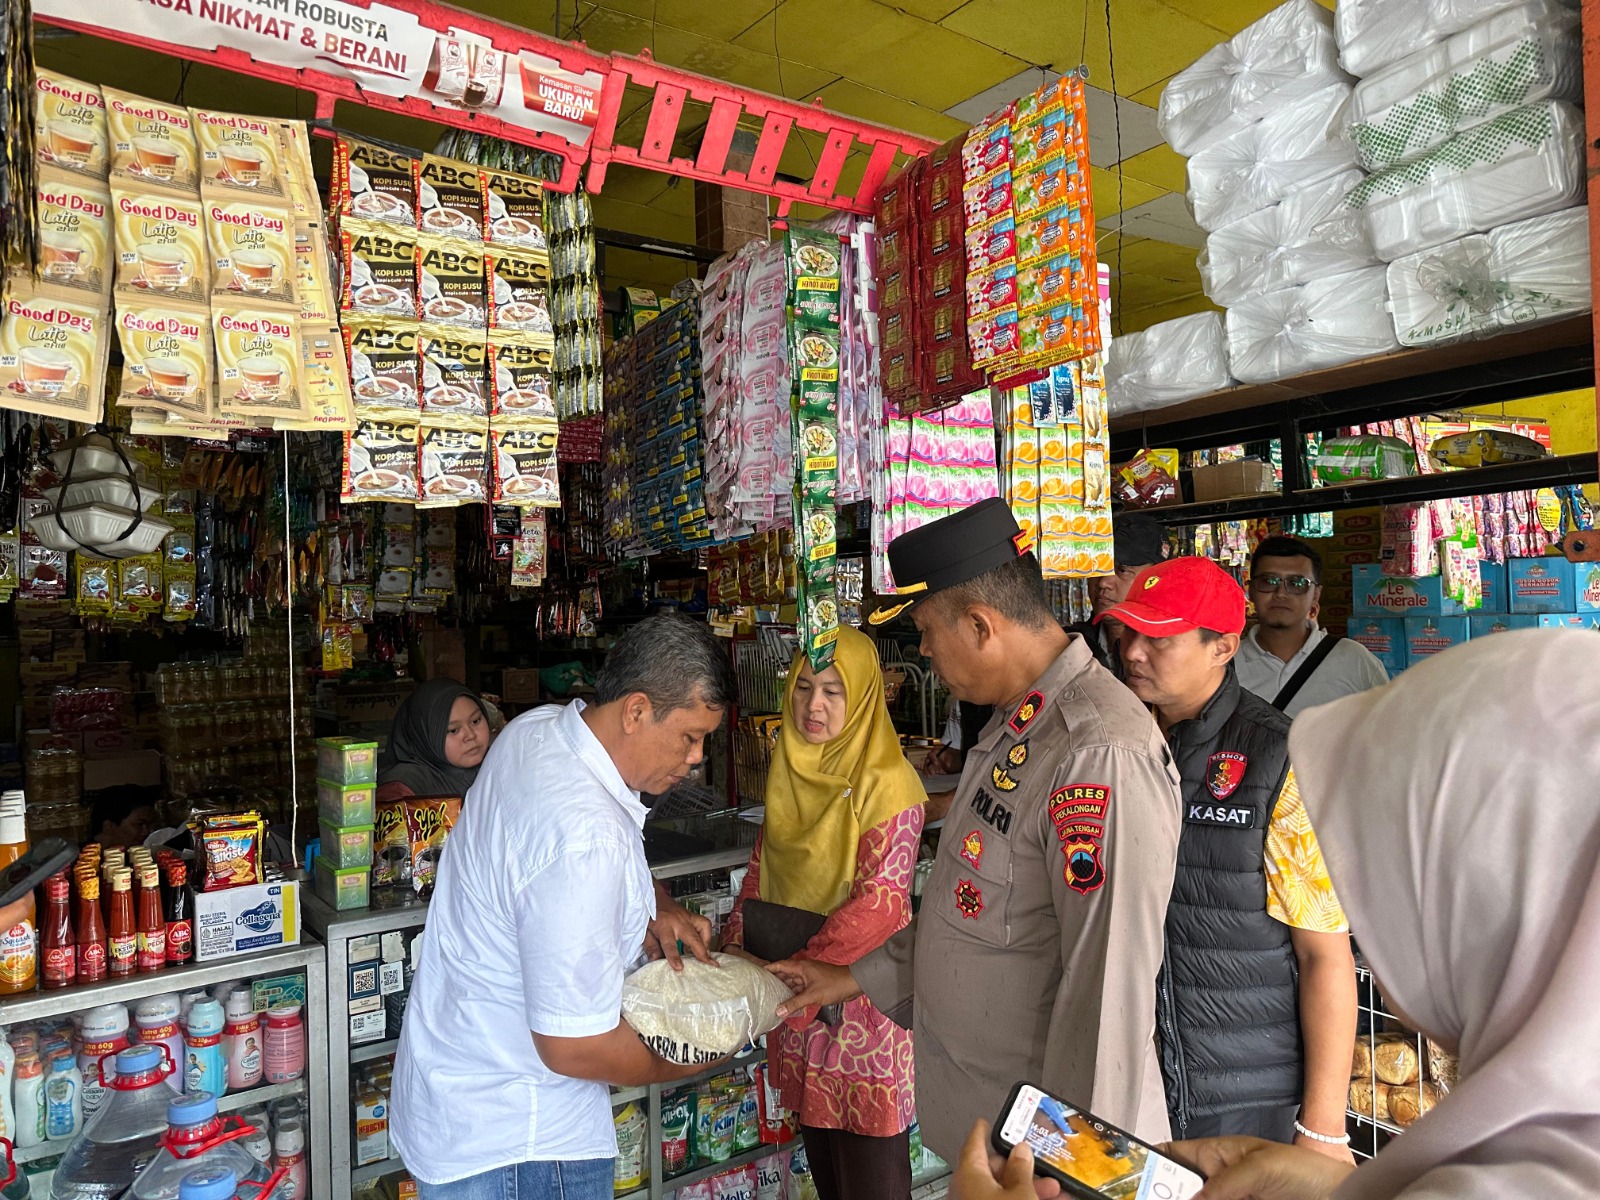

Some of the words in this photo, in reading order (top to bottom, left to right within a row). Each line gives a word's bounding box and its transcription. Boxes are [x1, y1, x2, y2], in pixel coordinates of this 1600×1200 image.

[294, 1, 389, 42] ROBUSTA
[200, 2, 296, 41] NIKMAT
[300, 27, 317, 49] &
[324, 33, 407, 73] BERANI
[36, 78, 82, 103] Good
[85, 92, 106, 109] Da
[539, 74, 572, 91] Kemasan
[573, 86, 594, 97] Silver
[538, 84, 594, 111] UKURAN
[111, 100, 157, 120] Good
[158, 110, 190, 130] Day
[544, 99, 585, 121] BARU!
[196, 112, 238, 129] Good
[238, 117, 268, 136] Day
[350, 146, 409, 172] ABC
[342, 182, 348, 190] 10
[373, 177, 392, 186] KOPI
[421, 163, 476, 190] ABC
[487, 174, 541, 198] ABC
[332, 187, 338, 196] 10
[441, 194, 460, 204] KOPI
[460, 195, 479, 204] SUSU
[38, 191, 66, 210] ood
[70, 196, 105, 218] Day
[120, 198, 164, 219] Good
[165, 204, 198, 226] Day
[508, 204, 525, 212] KOPI
[211, 206, 251, 226] Good
[252, 212, 284, 232] Day
[352, 236, 414, 260] ABC
[422, 250, 479, 274] ABC
[495, 257, 548, 280] ABC
[343, 276, 349, 289] 10
[375, 269, 392, 278] KOPI
[443, 282, 460, 290] KOPI
[461, 282, 482, 291] SUSU
[819, 279, 836, 290] SAYUR
[8, 300, 55, 325] Good
[56, 310, 92, 333] Day
[123, 313, 166, 334] Good
[168, 318, 200, 340] Day
[220, 316, 259, 333] Good
[260, 320, 291, 338] Day
[352, 329, 415, 351] ABC
[422, 338, 481, 362] ABC
[496, 344, 551, 364] ABC
[375, 360, 393, 370] KOPI
[394, 360, 417, 369] SUSU
[446, 371, 462, 380] KOPI
[463, 371, 484, 380] SUSU
[354, 422, 415, 442] ABC
[425, 428, 484, 450] ABC
[500, 430, 557, 450] ABC
[374, 453, 392, 462] KOPI
[394, 454, 416, 462] SUSU
[463, 459, 484, 468] SUSU
[520, 460, 537, 468] KOPI
[538, 458, 556, 468] SUSU
[342, 463, 348, 475] 10
[1387, 581, 1404, 595] Le
[1366, 592, 1428, 608] Minerale
[1050, 788, 1106, 810] POLRES
[970, 786, 1012, 835] POLRI
[1055, 805, 1102, 822] PEKALONGAN
[1188, 805, 1250, 825] KASAT
[212, 842, 244, 863] alkist
[236, 912, 280, 926] Collagena
[172, 928, 189, 938] ABC
[88, 948, 102, 956] ABC
[740, 1100, 758, 1114] Klin
[715, 1116, 736, 1132] Klin
